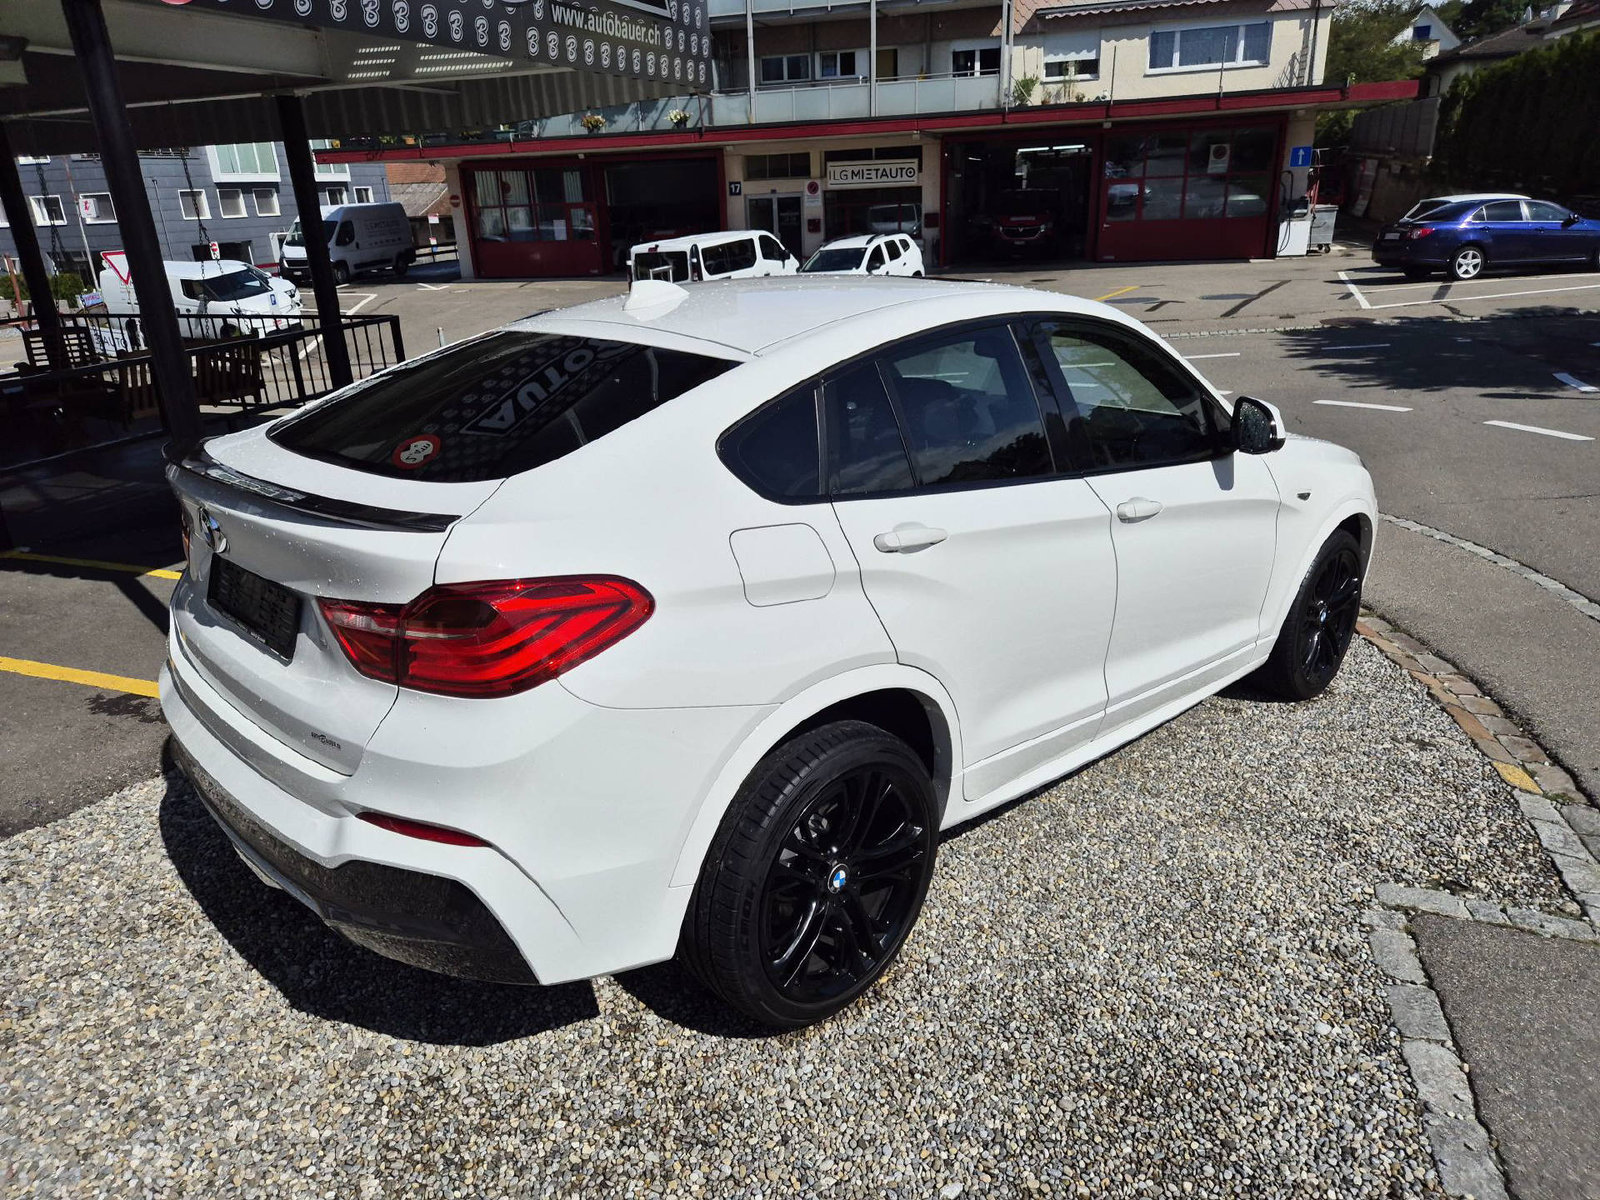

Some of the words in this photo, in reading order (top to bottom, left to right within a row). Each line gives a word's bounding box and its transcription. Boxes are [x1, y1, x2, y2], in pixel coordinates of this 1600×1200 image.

[551, 4, 661, 46] www.autobauer.ch
[829, 169, 849, 181] ILG
[851, 166, 916, 180] MIETAUTO
[731, 183, 740, 193] 17
